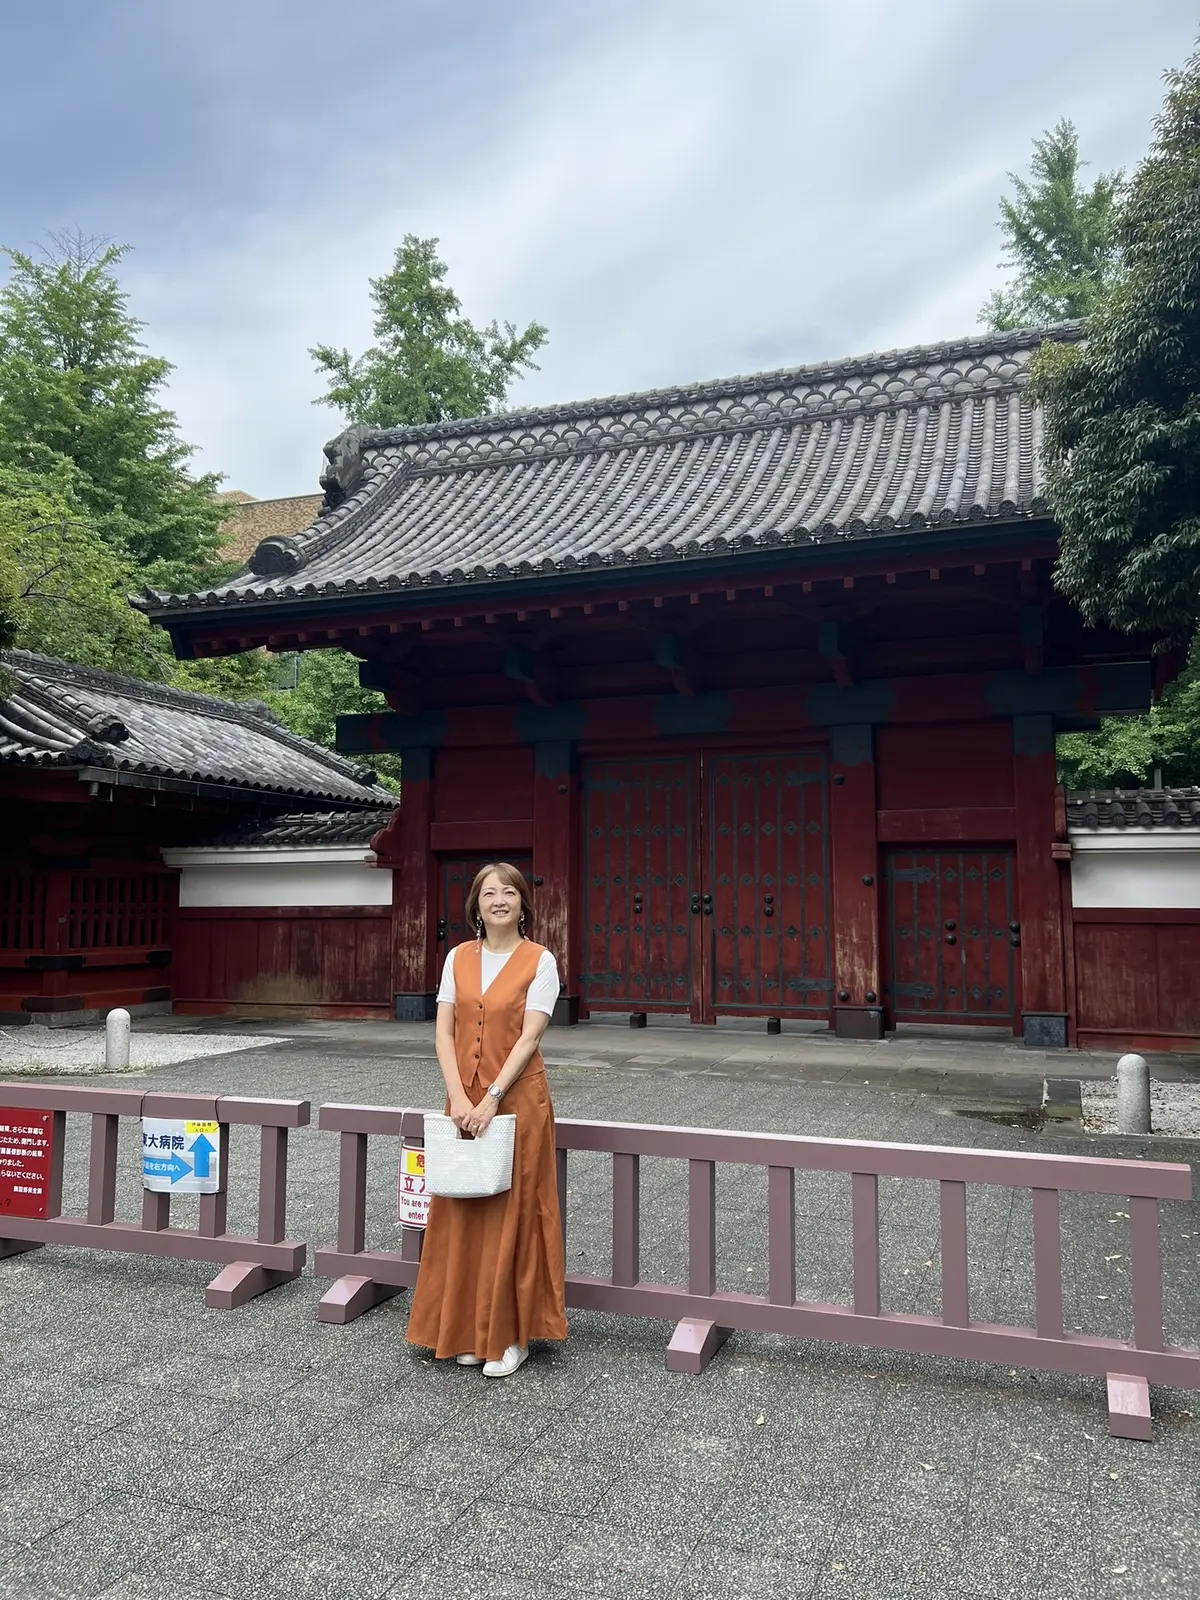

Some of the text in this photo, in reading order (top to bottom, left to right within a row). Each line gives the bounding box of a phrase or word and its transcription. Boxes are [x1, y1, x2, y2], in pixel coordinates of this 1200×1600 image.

[0, 1169, 44, 1181] らないでください。
[401, 1196, 410, 1206] You
[411, 1200, 422, 1208] are
[408, 1212, 425, 1220] enter
